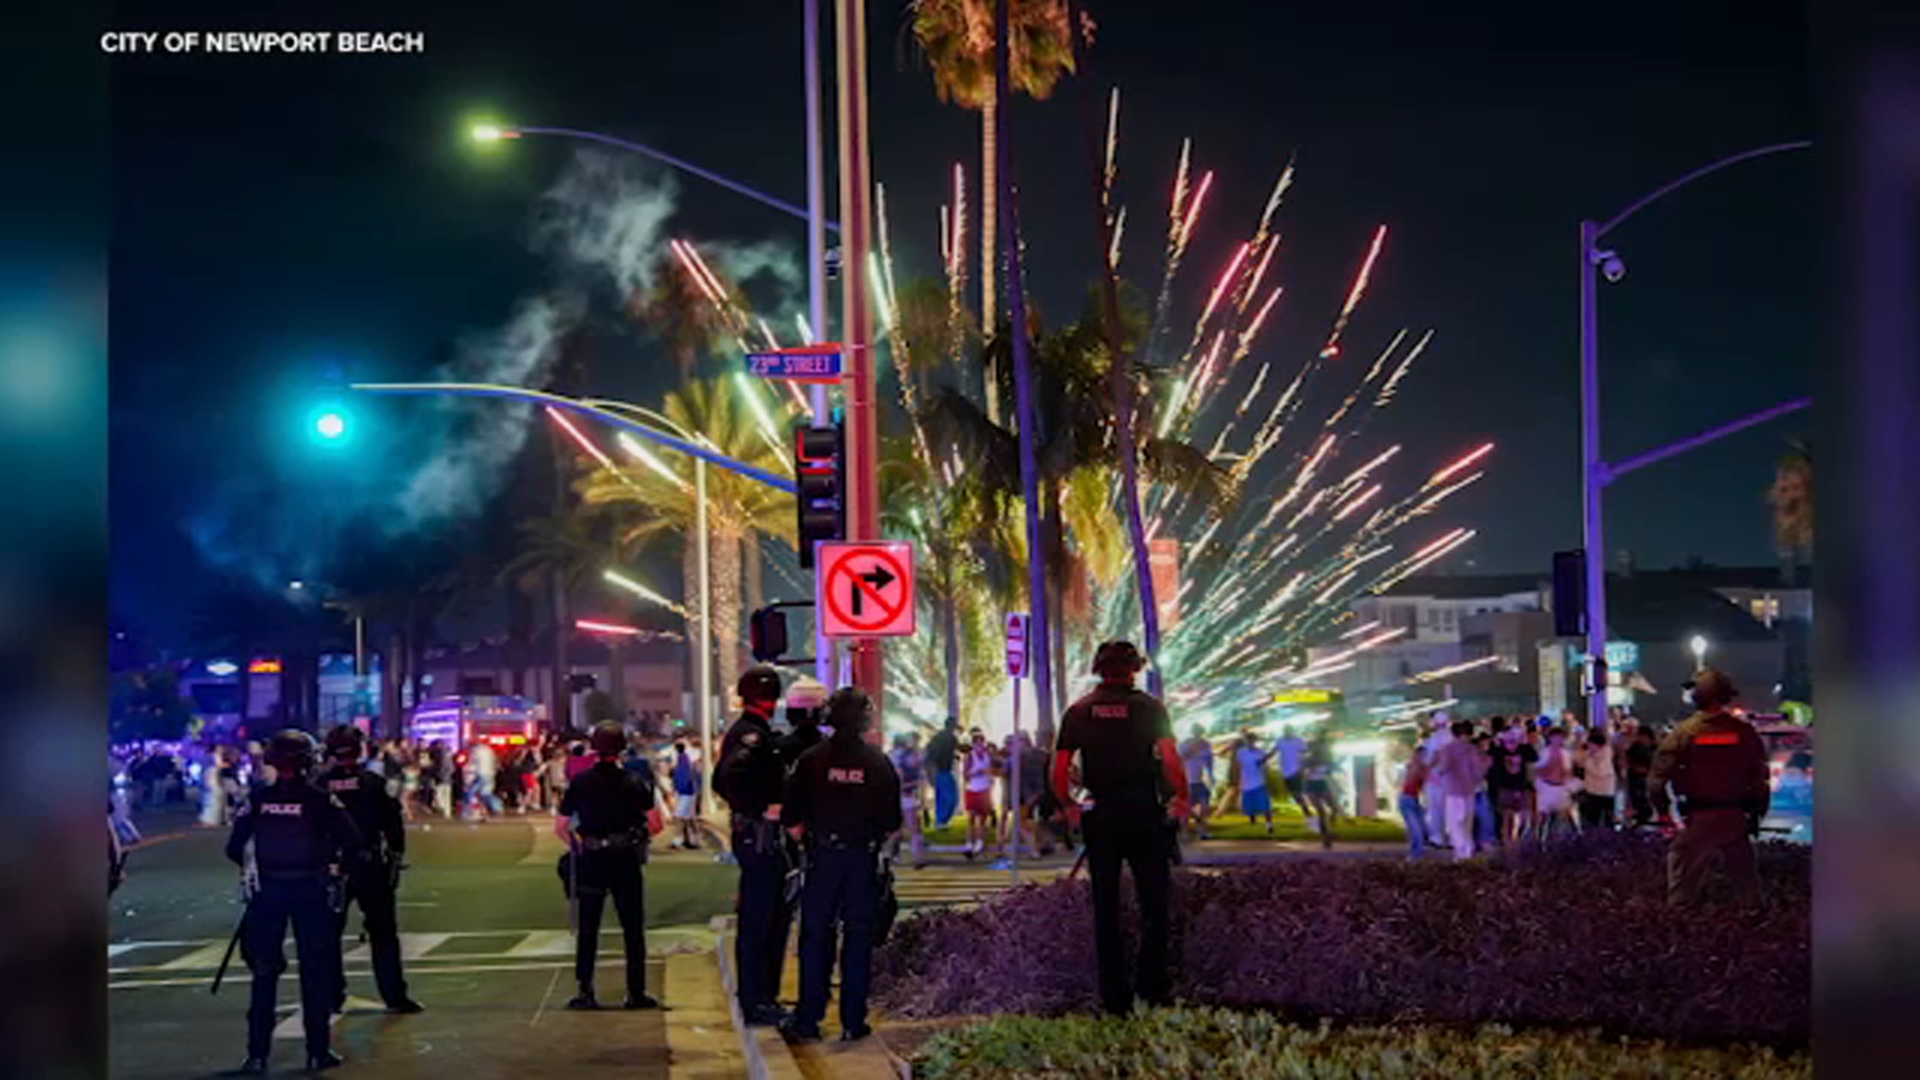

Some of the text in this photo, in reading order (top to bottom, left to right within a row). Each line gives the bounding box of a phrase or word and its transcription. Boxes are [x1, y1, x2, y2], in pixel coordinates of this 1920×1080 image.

[784, 355, 830, 374] STREET
[1092, 705, 1129, 719] POLICE
[828, 768, 865, 784] POLICE
[261, 803, 302, 815] POLICE
